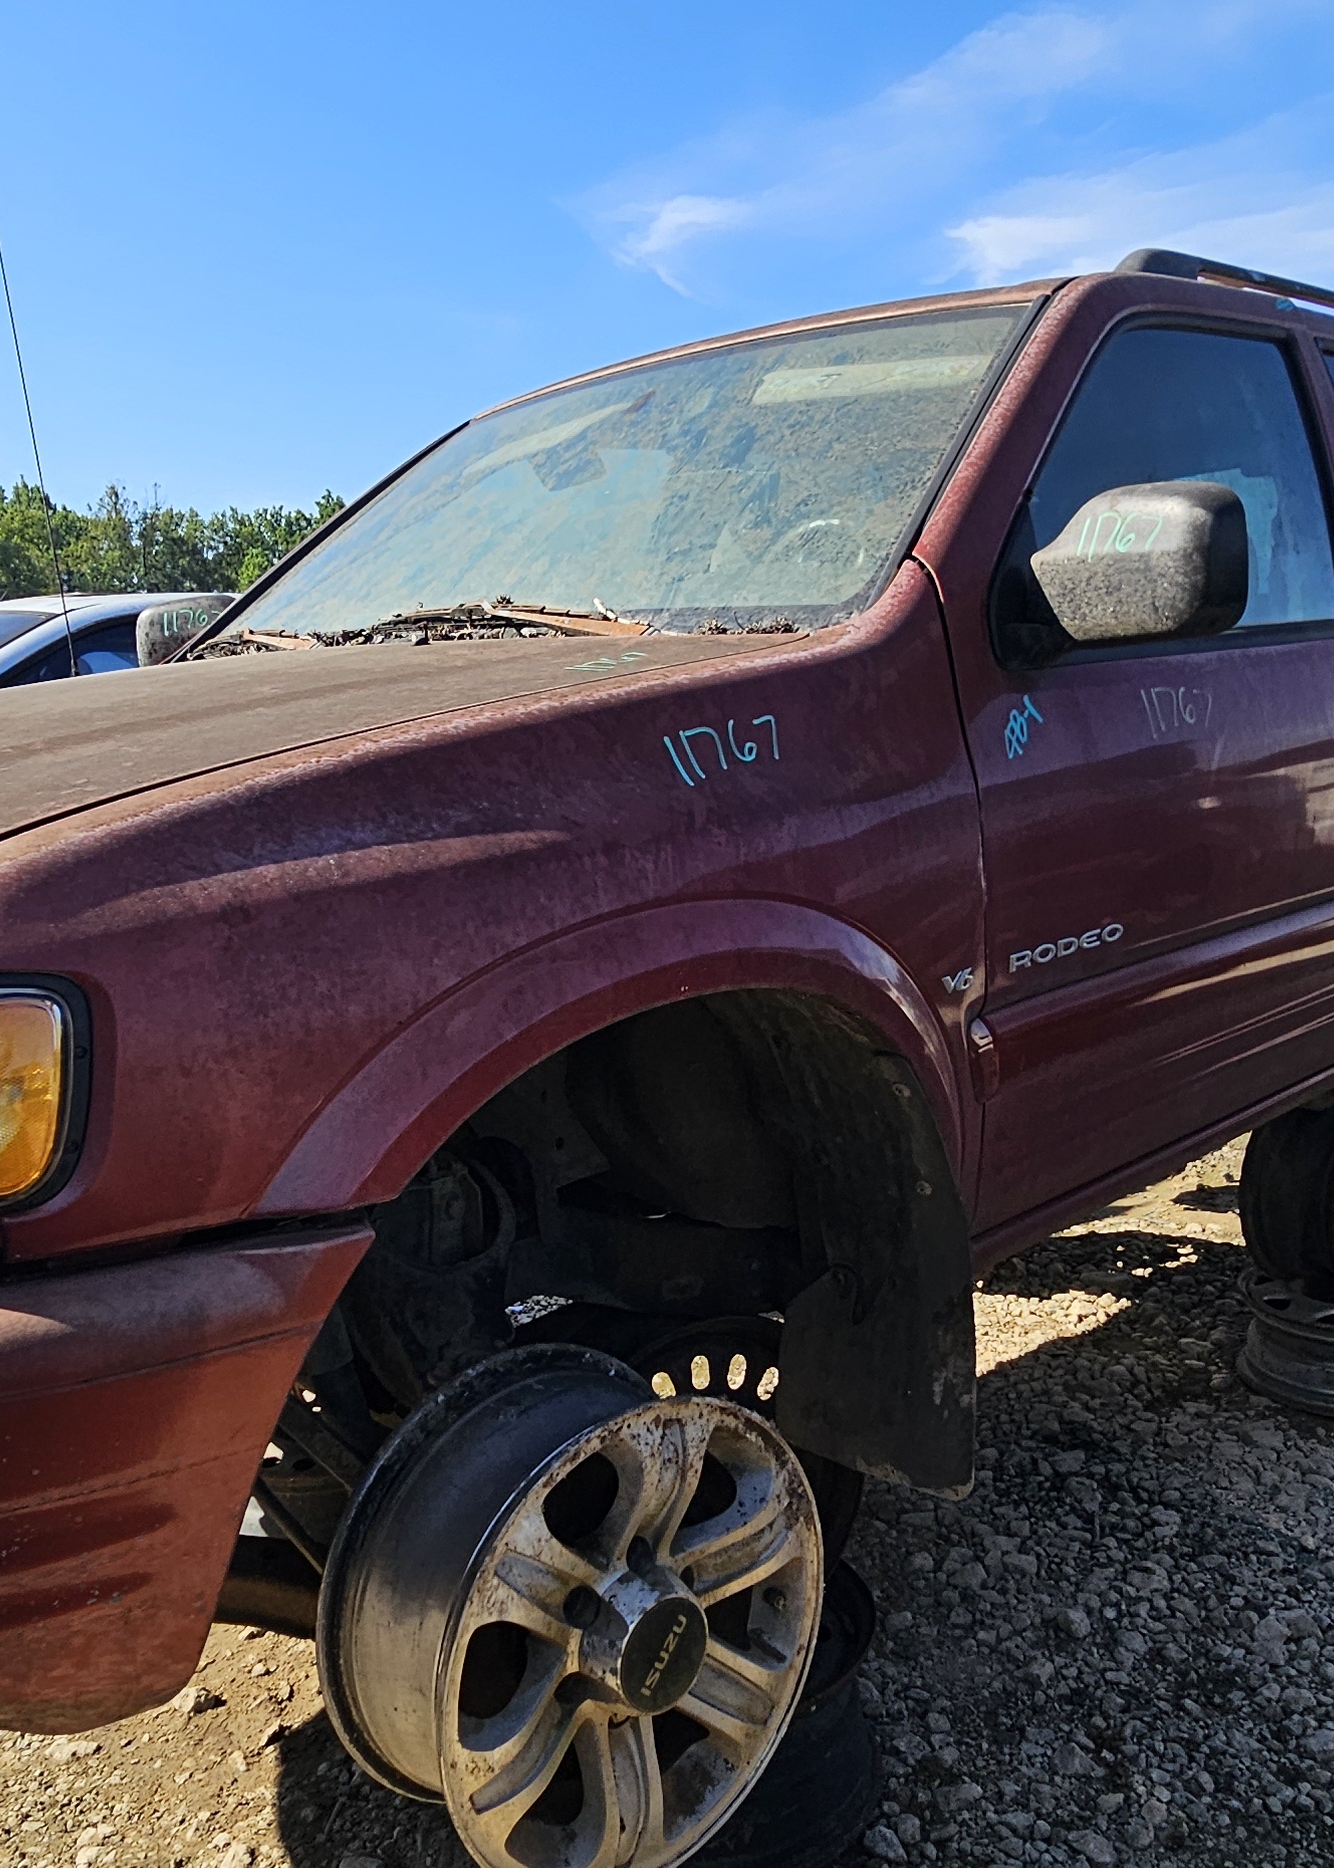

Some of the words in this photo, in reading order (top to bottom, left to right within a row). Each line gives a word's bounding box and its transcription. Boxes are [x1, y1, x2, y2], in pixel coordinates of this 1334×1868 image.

[1076, 511, 1164, 563] 11767
[1140, 686, 1212, 740] 11767
[663, 714, 780, 787] 11767
[1008, 923, 1125, 973] RODEO
[941, 966, 974, 994] V6
[640, 1614, 687, 1697] ISUZU
